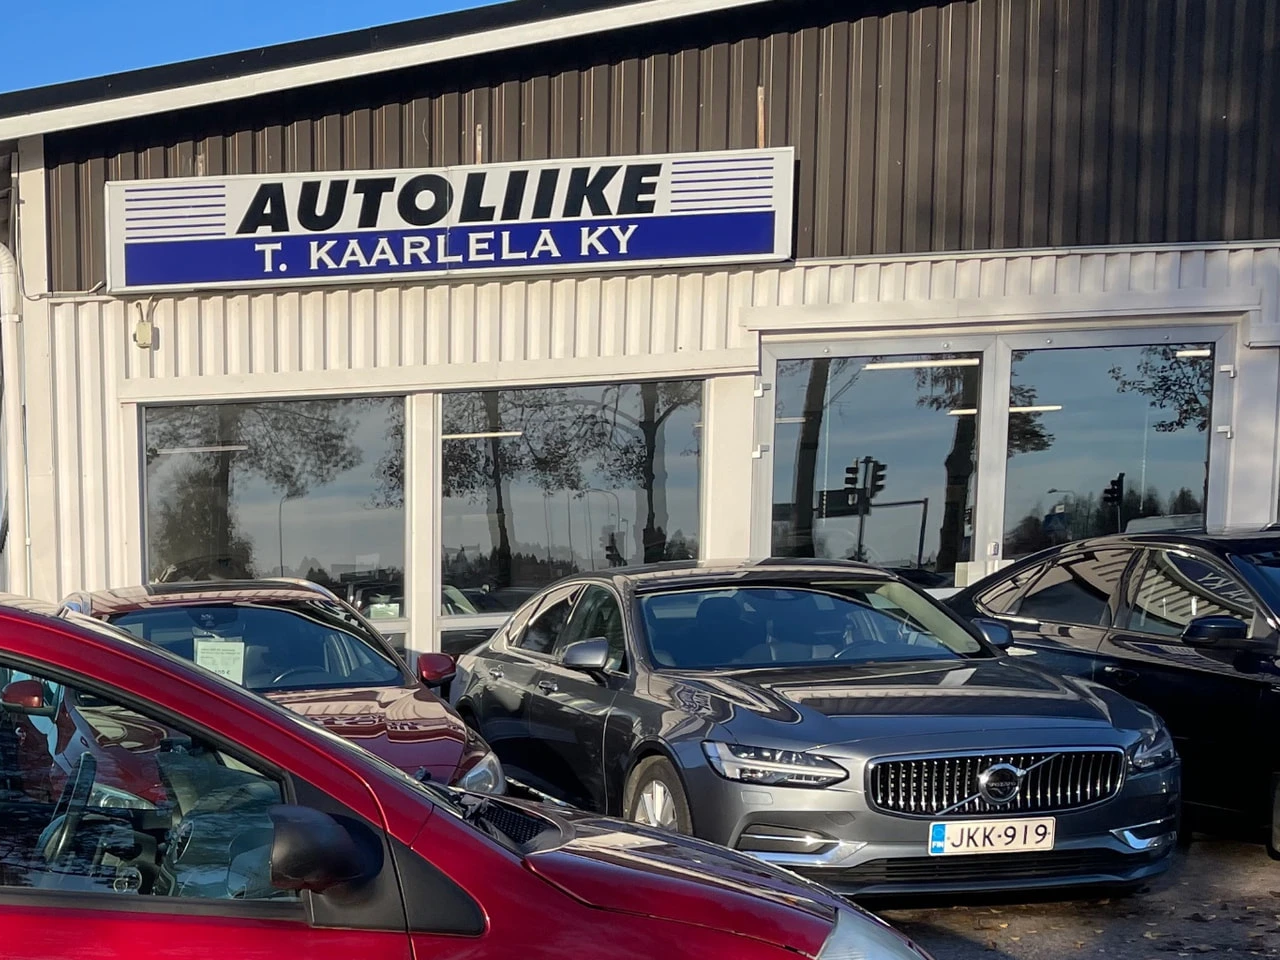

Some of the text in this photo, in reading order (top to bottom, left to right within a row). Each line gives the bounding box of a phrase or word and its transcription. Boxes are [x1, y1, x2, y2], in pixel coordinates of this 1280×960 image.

[235, 163, 663, 236] AUTOLIIKE
[254, 223, 639, 273] T. KAARLELA KY
[951, 824, 1048, 848] JKK-919
